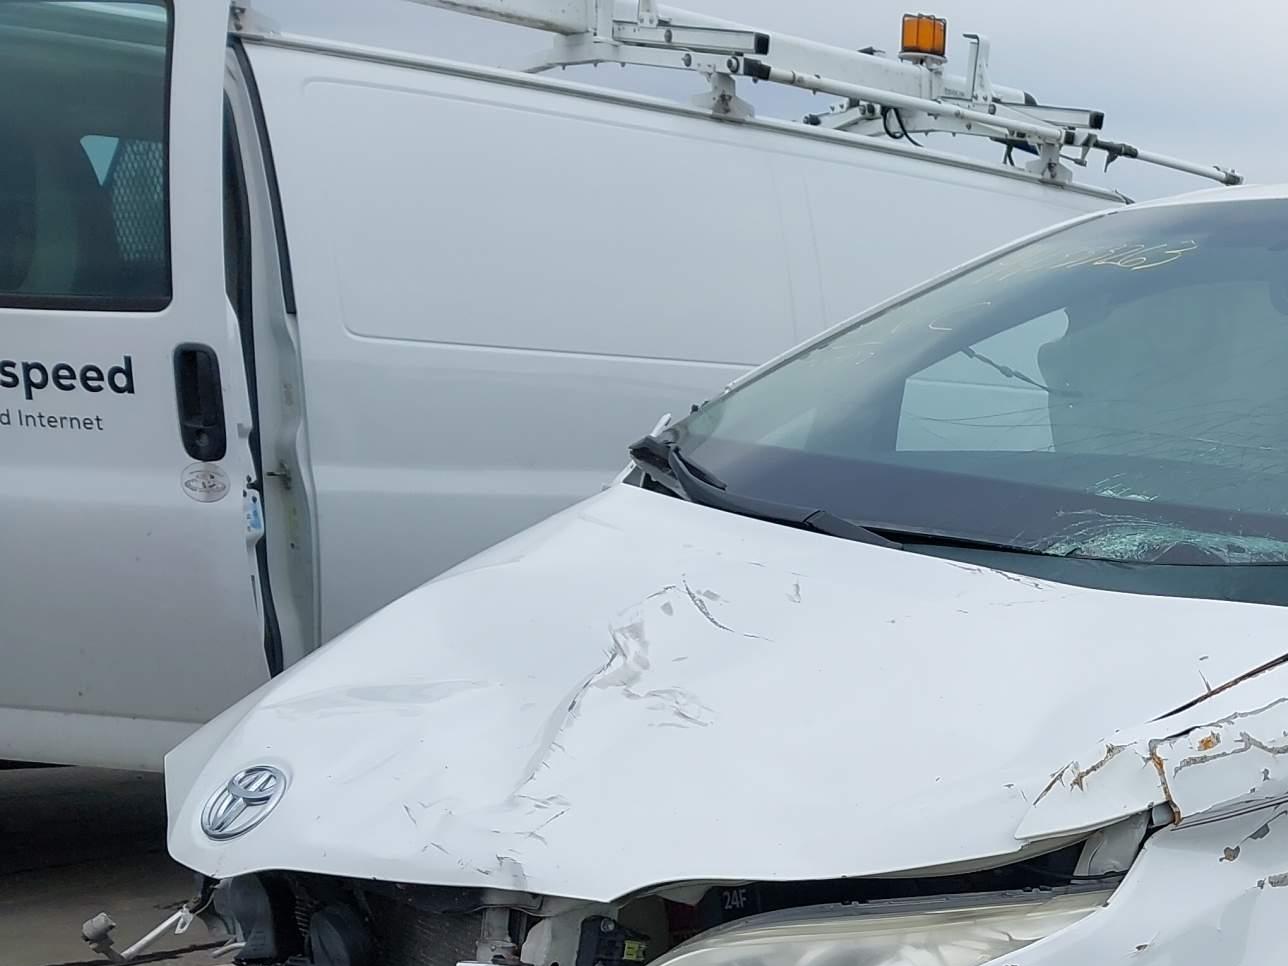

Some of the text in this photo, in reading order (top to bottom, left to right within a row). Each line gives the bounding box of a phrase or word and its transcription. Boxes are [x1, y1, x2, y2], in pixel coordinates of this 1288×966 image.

[0, 355, 135, 400] speed
[18, 409, 104, 431] Internet
[722, 888, 747, 910] 24F
